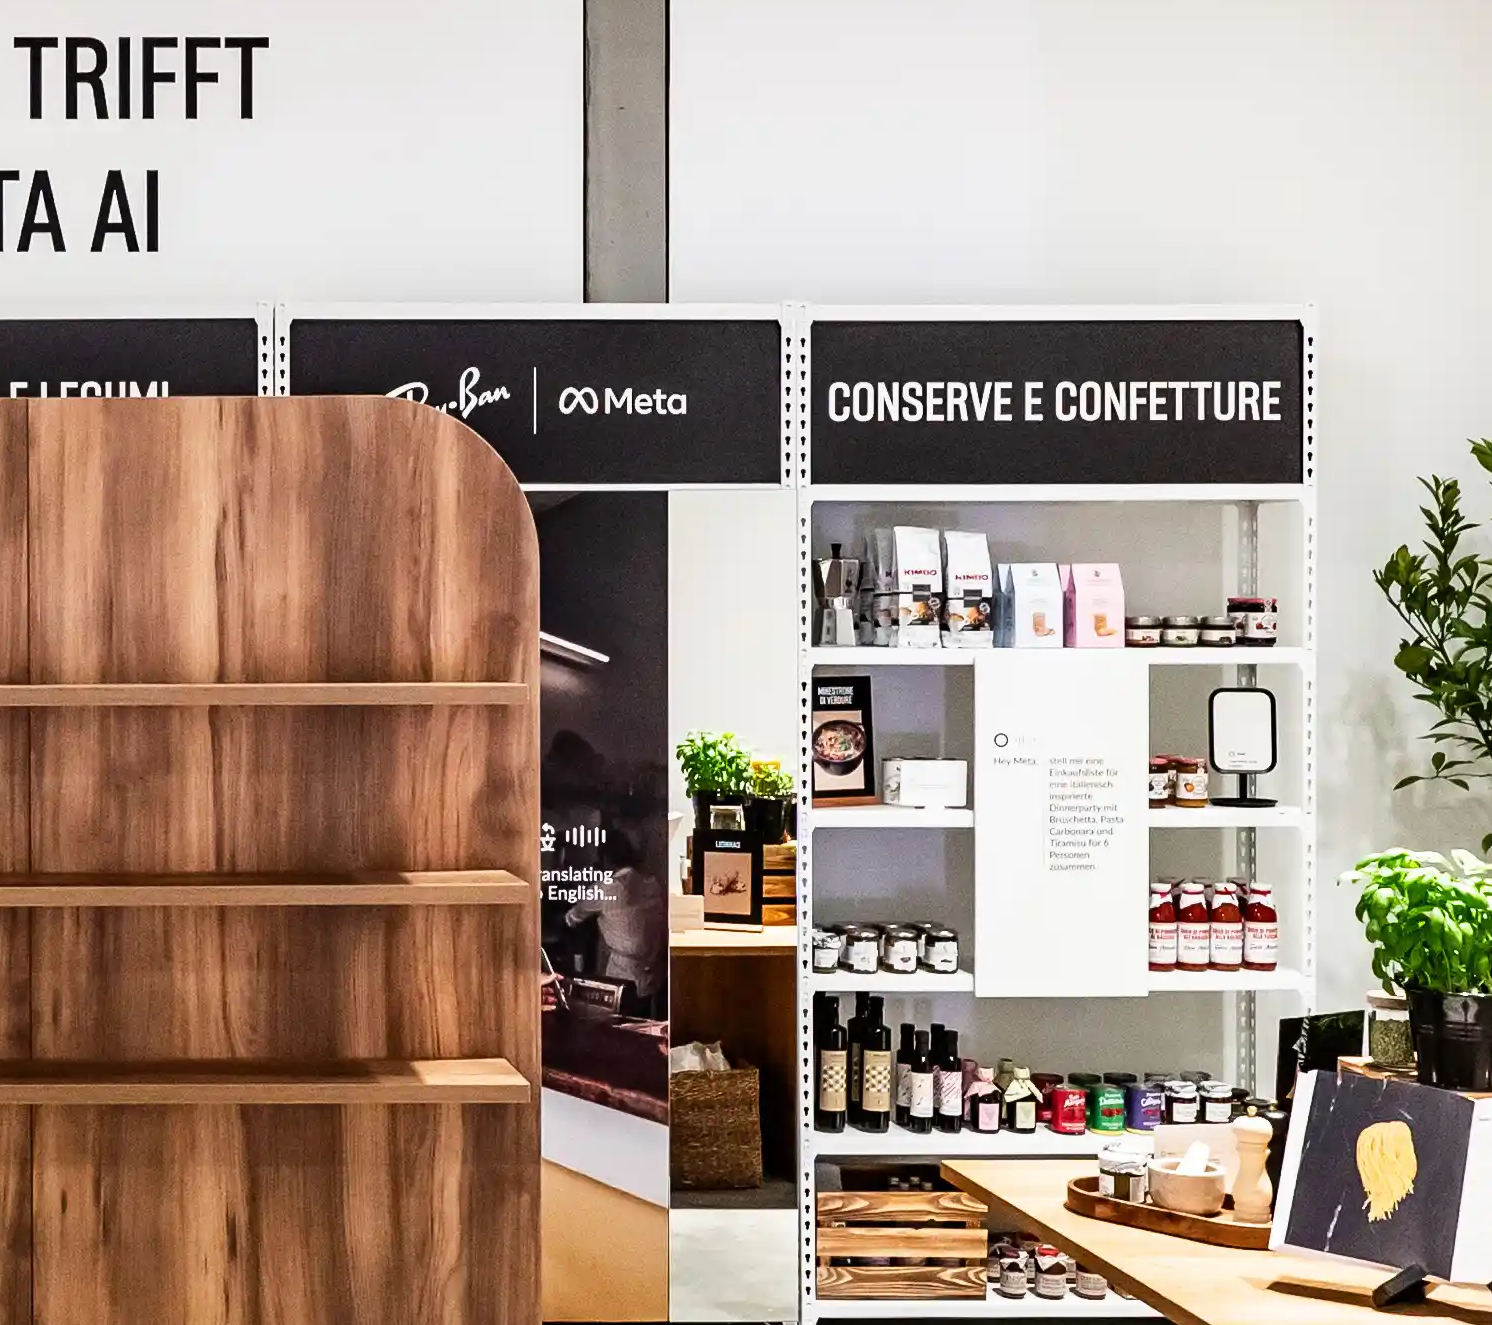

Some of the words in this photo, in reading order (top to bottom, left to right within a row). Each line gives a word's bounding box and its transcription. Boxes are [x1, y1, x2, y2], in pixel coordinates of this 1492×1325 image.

[14, 37, 269, 119] TRIFFT
[91, 170, 158, 252] AI
[605, 388, 686, 414] Meta
[829, 382, 1012, 422] CONSERVE
[1025, 382, 1043, 421] E
[1056, 381, 1281, 421] CONFETTURE
[1100, 816, 1124, 824] Pasta
[1049, 850, 1090, 859] Personen
[539, 866, 614, 885] anslating
